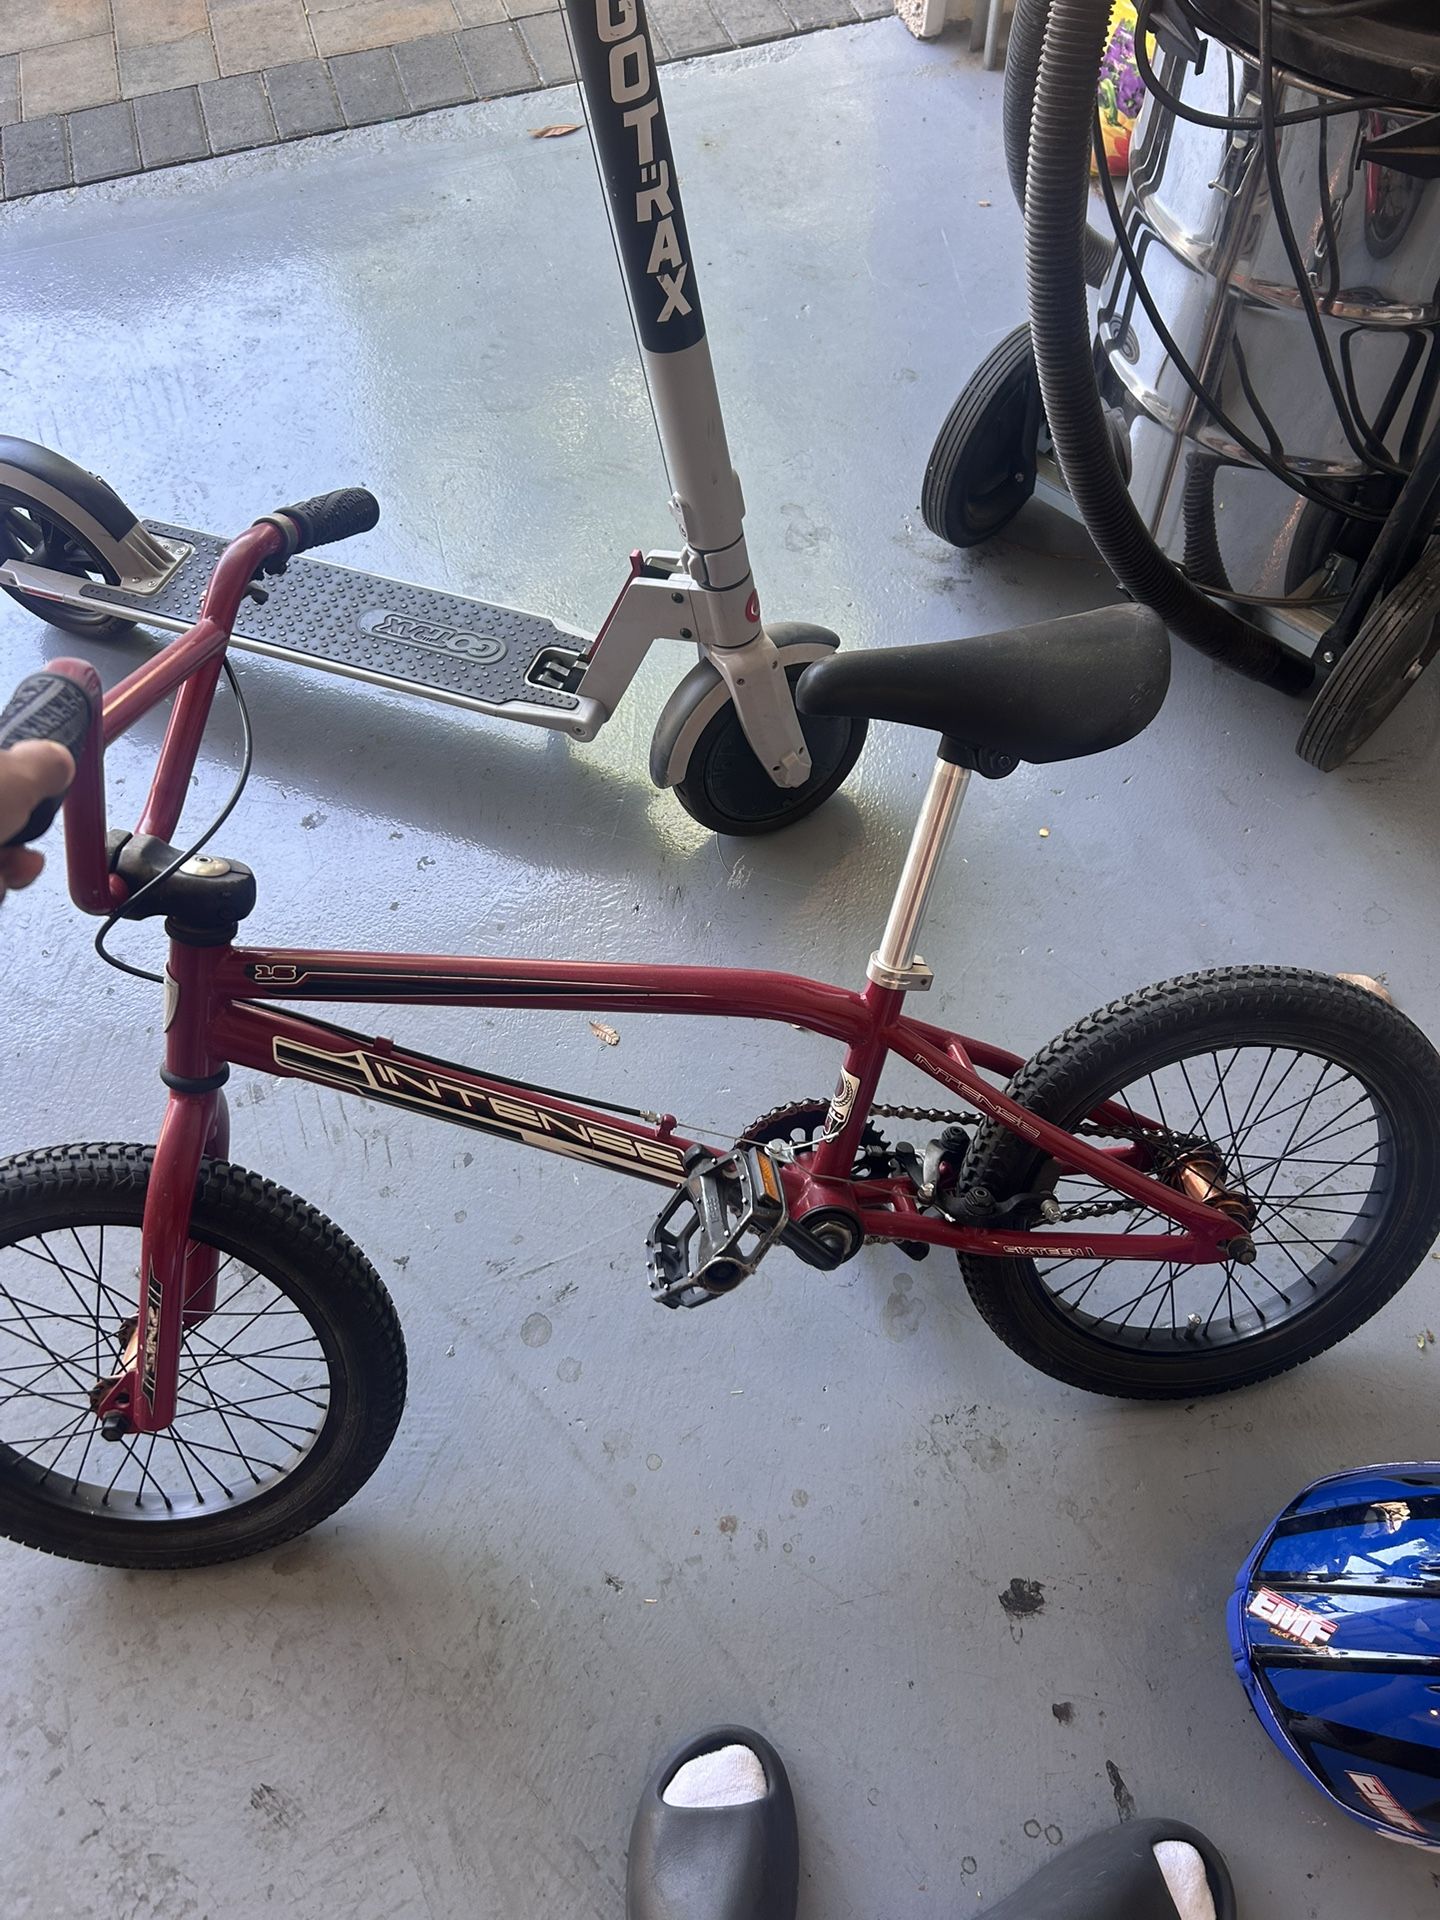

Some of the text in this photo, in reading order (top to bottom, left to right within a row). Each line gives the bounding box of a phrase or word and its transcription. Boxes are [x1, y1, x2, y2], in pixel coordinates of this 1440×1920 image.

[594, 0, 692, 323] GOTRAX
[373, 614, 501, 658] GOTRAX
[255, 965, 297, 980] 16
[376, 1062, 685, 1172] INTENSE
[914, 1054, 1040, 1138] INTENSE
[1003, 1245, 1084, 1257] SIXTEEN
[1249, 1586, 1339, 1643] EMF
